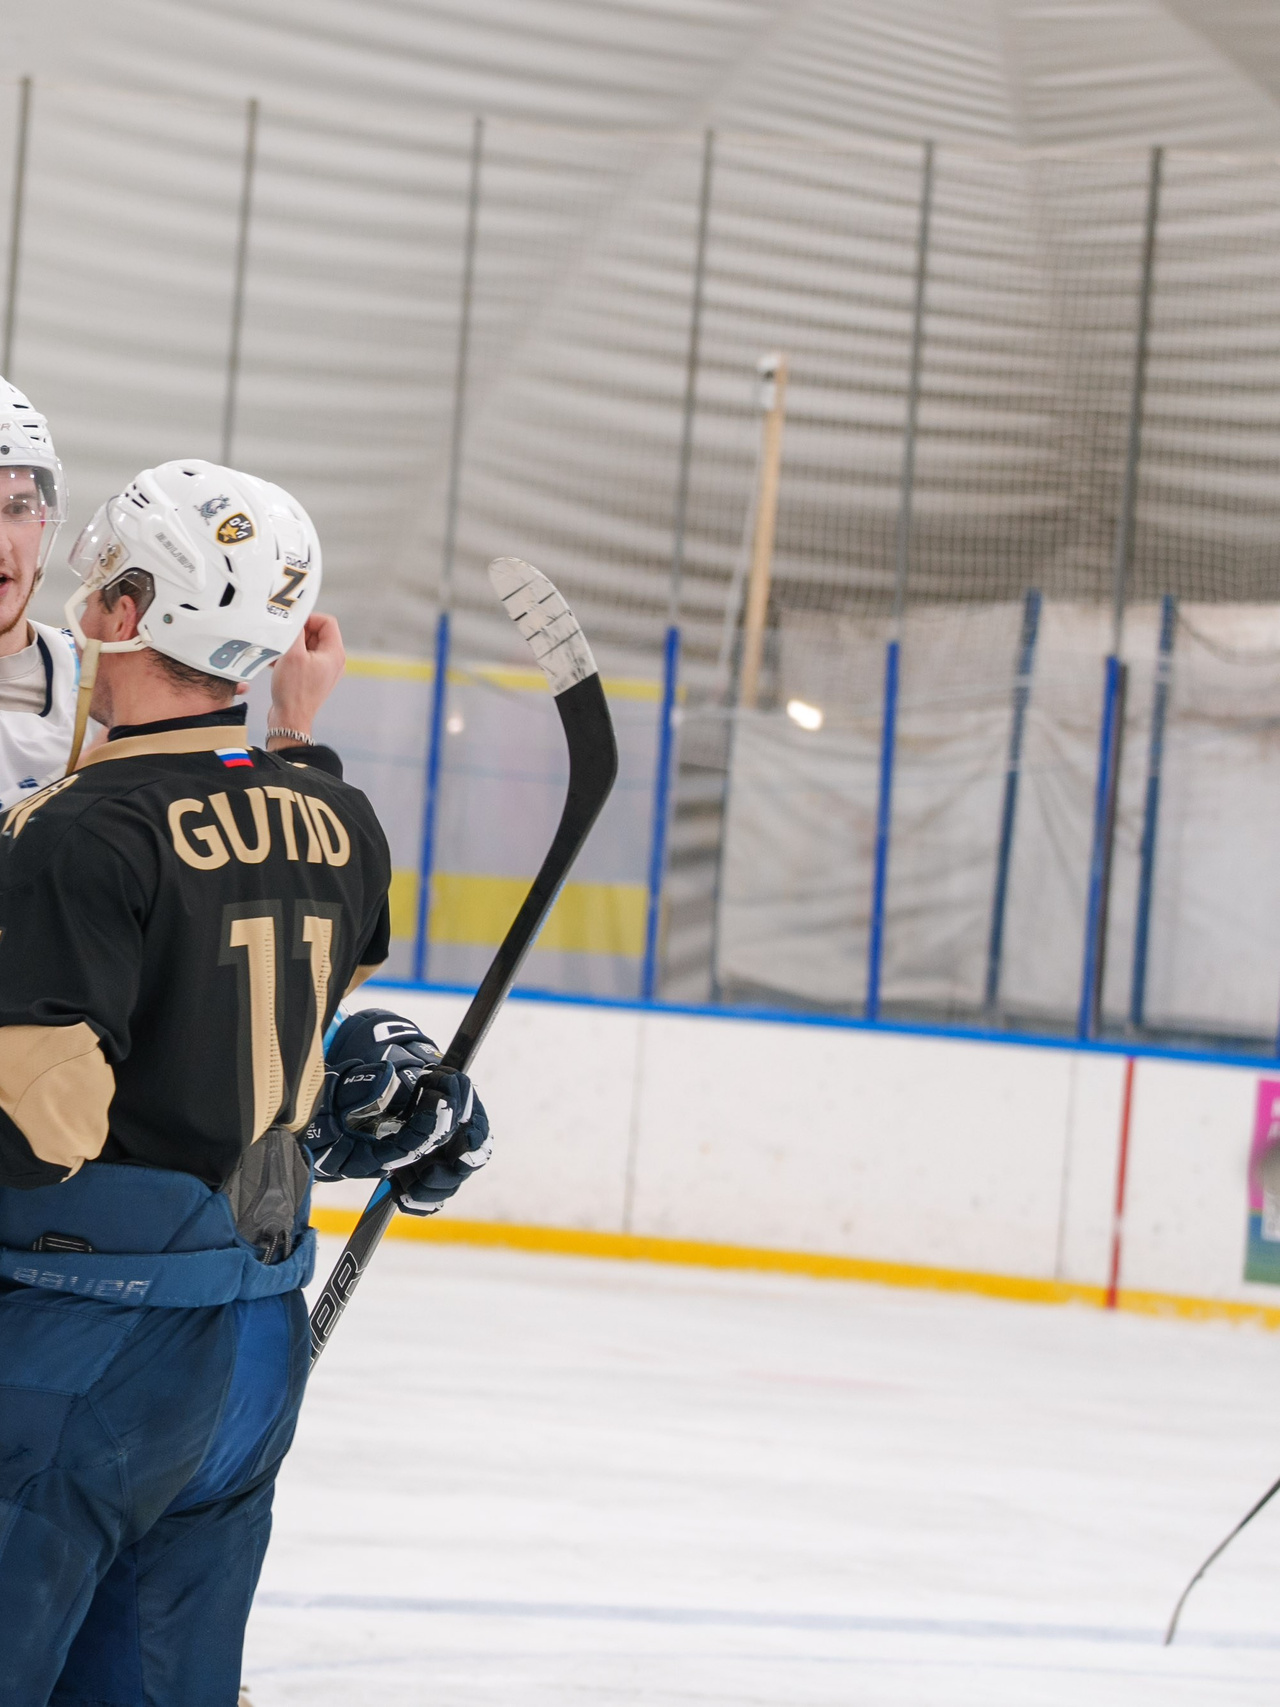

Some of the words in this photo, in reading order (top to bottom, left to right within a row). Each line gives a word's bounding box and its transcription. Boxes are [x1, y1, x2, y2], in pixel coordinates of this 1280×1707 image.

[166, 786, 351, 871] GUTID
[229, 915, 334, 1146] 11
[343, 1073, 377, 1086] CCM
[12, 1266, 154, 1299] BAUER
